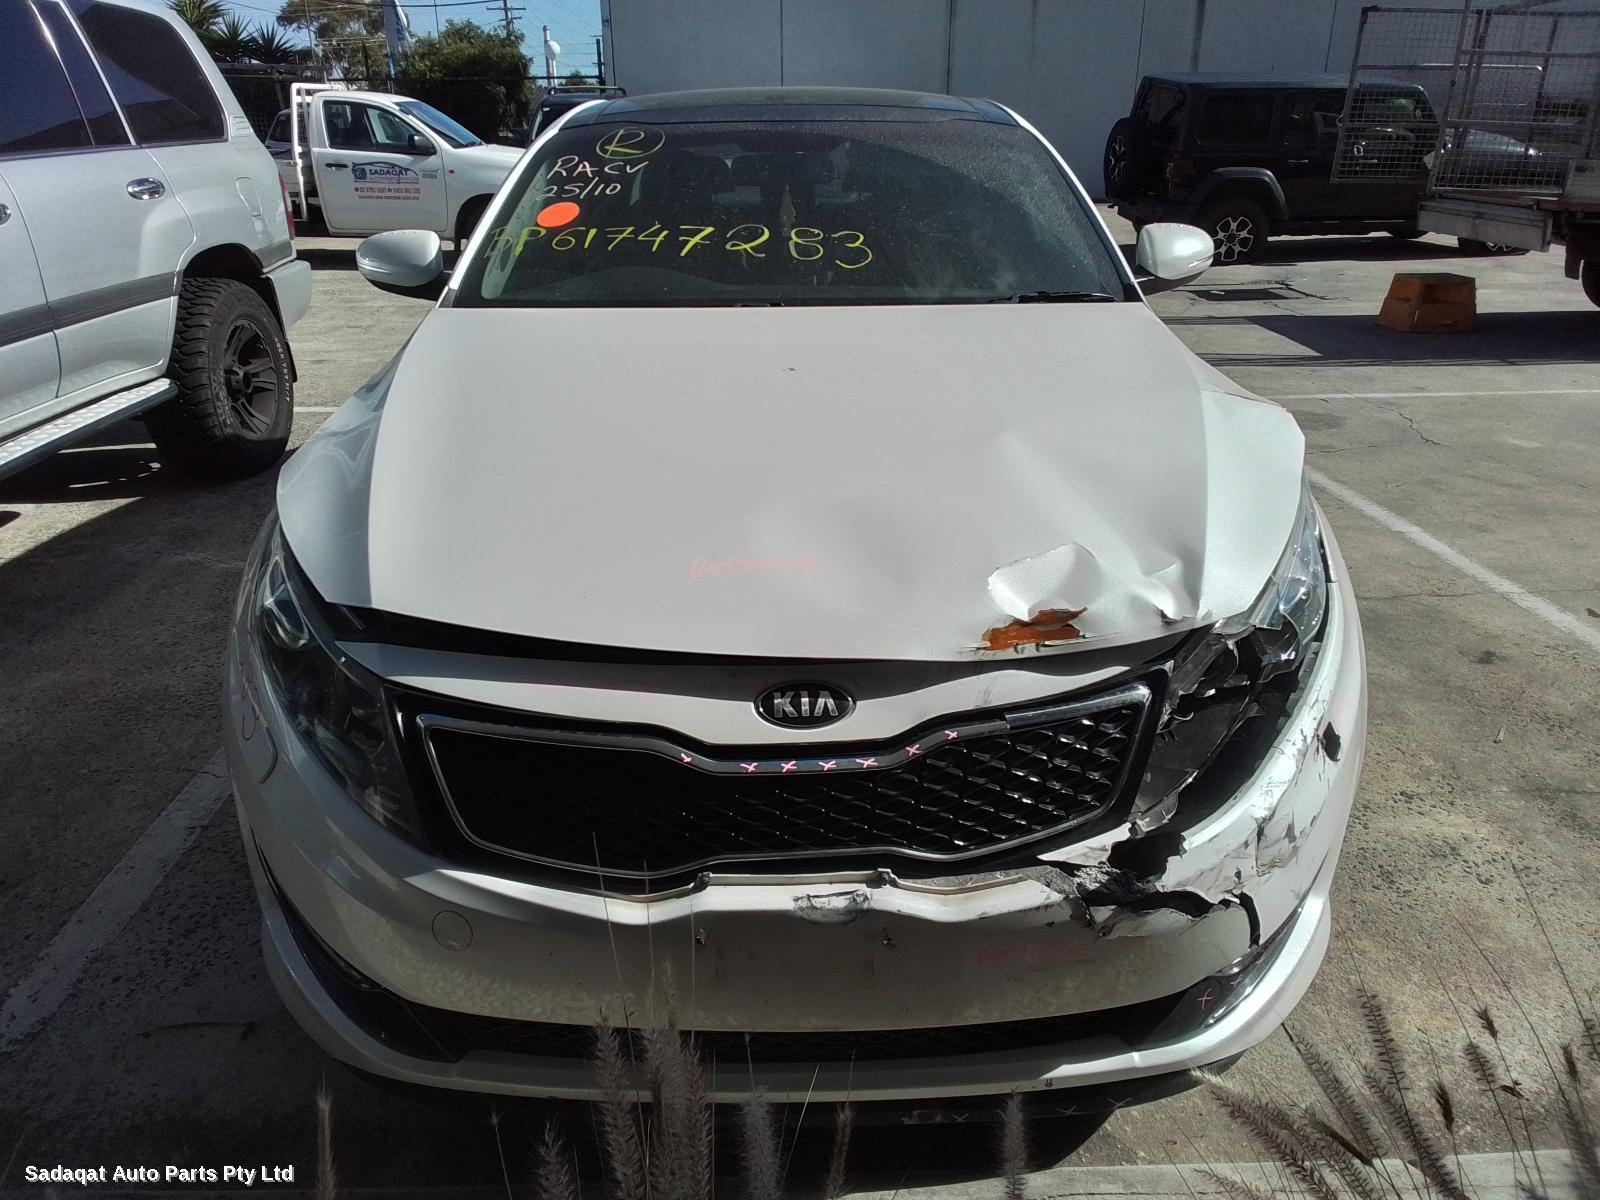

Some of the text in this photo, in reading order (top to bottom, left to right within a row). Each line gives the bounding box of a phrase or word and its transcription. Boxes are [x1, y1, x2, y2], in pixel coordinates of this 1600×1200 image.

[368, 168, 409, 177] SADAQAT
[546, 155, 650, 180] RACV
[535, 176, 622, 201] 25/10
[773, 690, 839, 718] KIA
